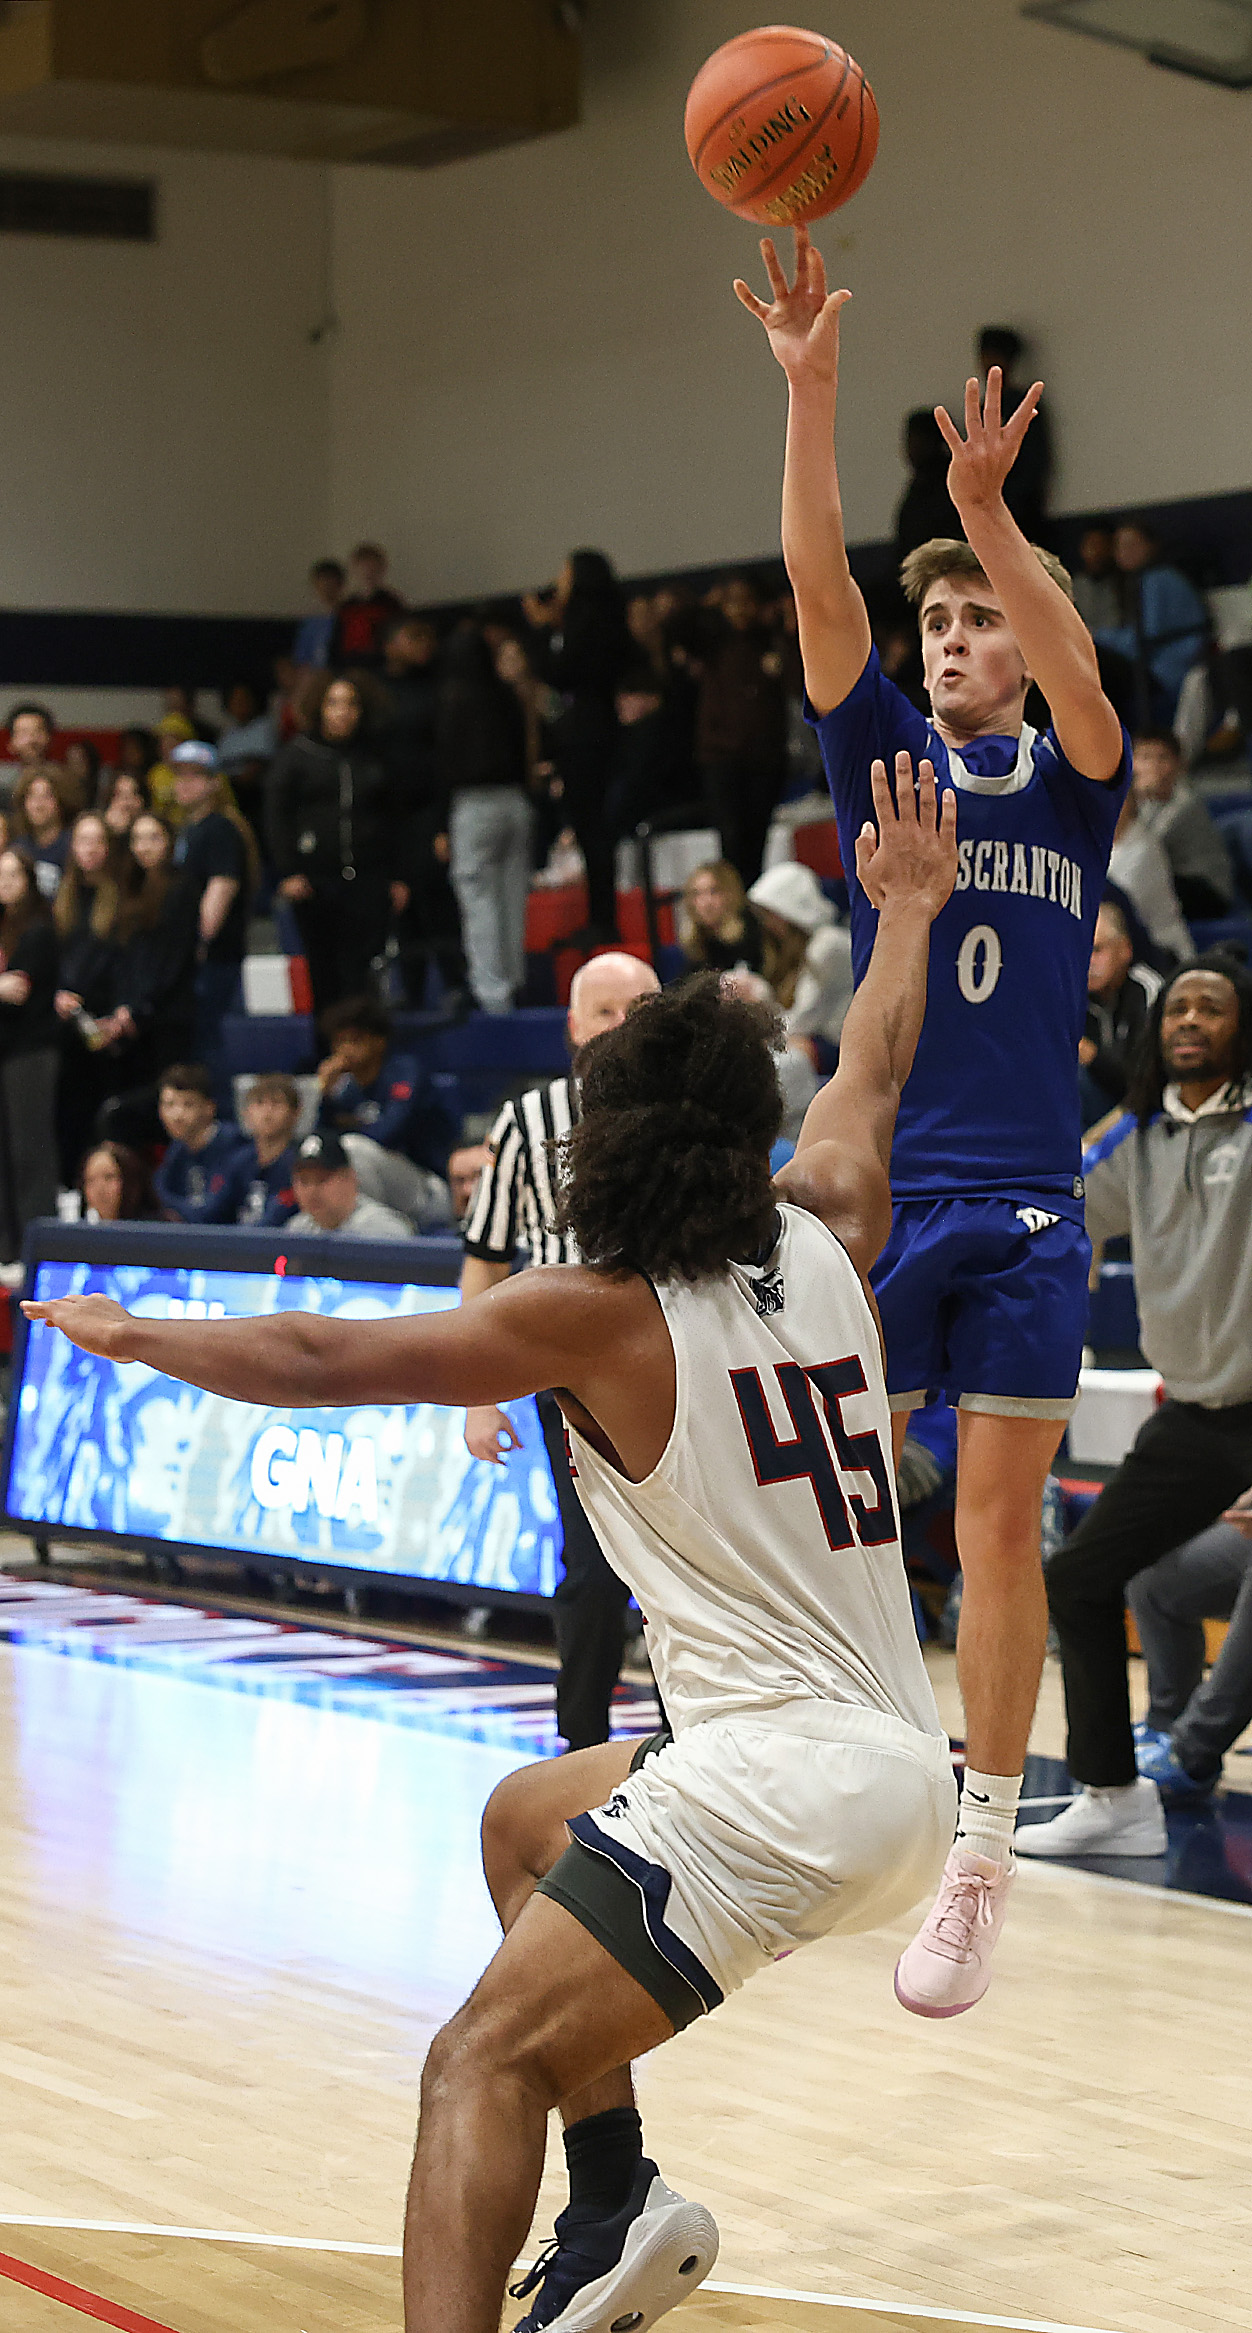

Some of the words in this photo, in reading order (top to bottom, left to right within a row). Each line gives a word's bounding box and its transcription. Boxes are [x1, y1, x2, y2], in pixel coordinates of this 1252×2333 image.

[711, 96, 812, 193] SPALDING
[955, 840, 1082, 920] SCRANTON
[956, 924, 1003, 1004] 0
[252, 1425, 379, 1520] GNA
[728, 1354, 898, 1551] 45
